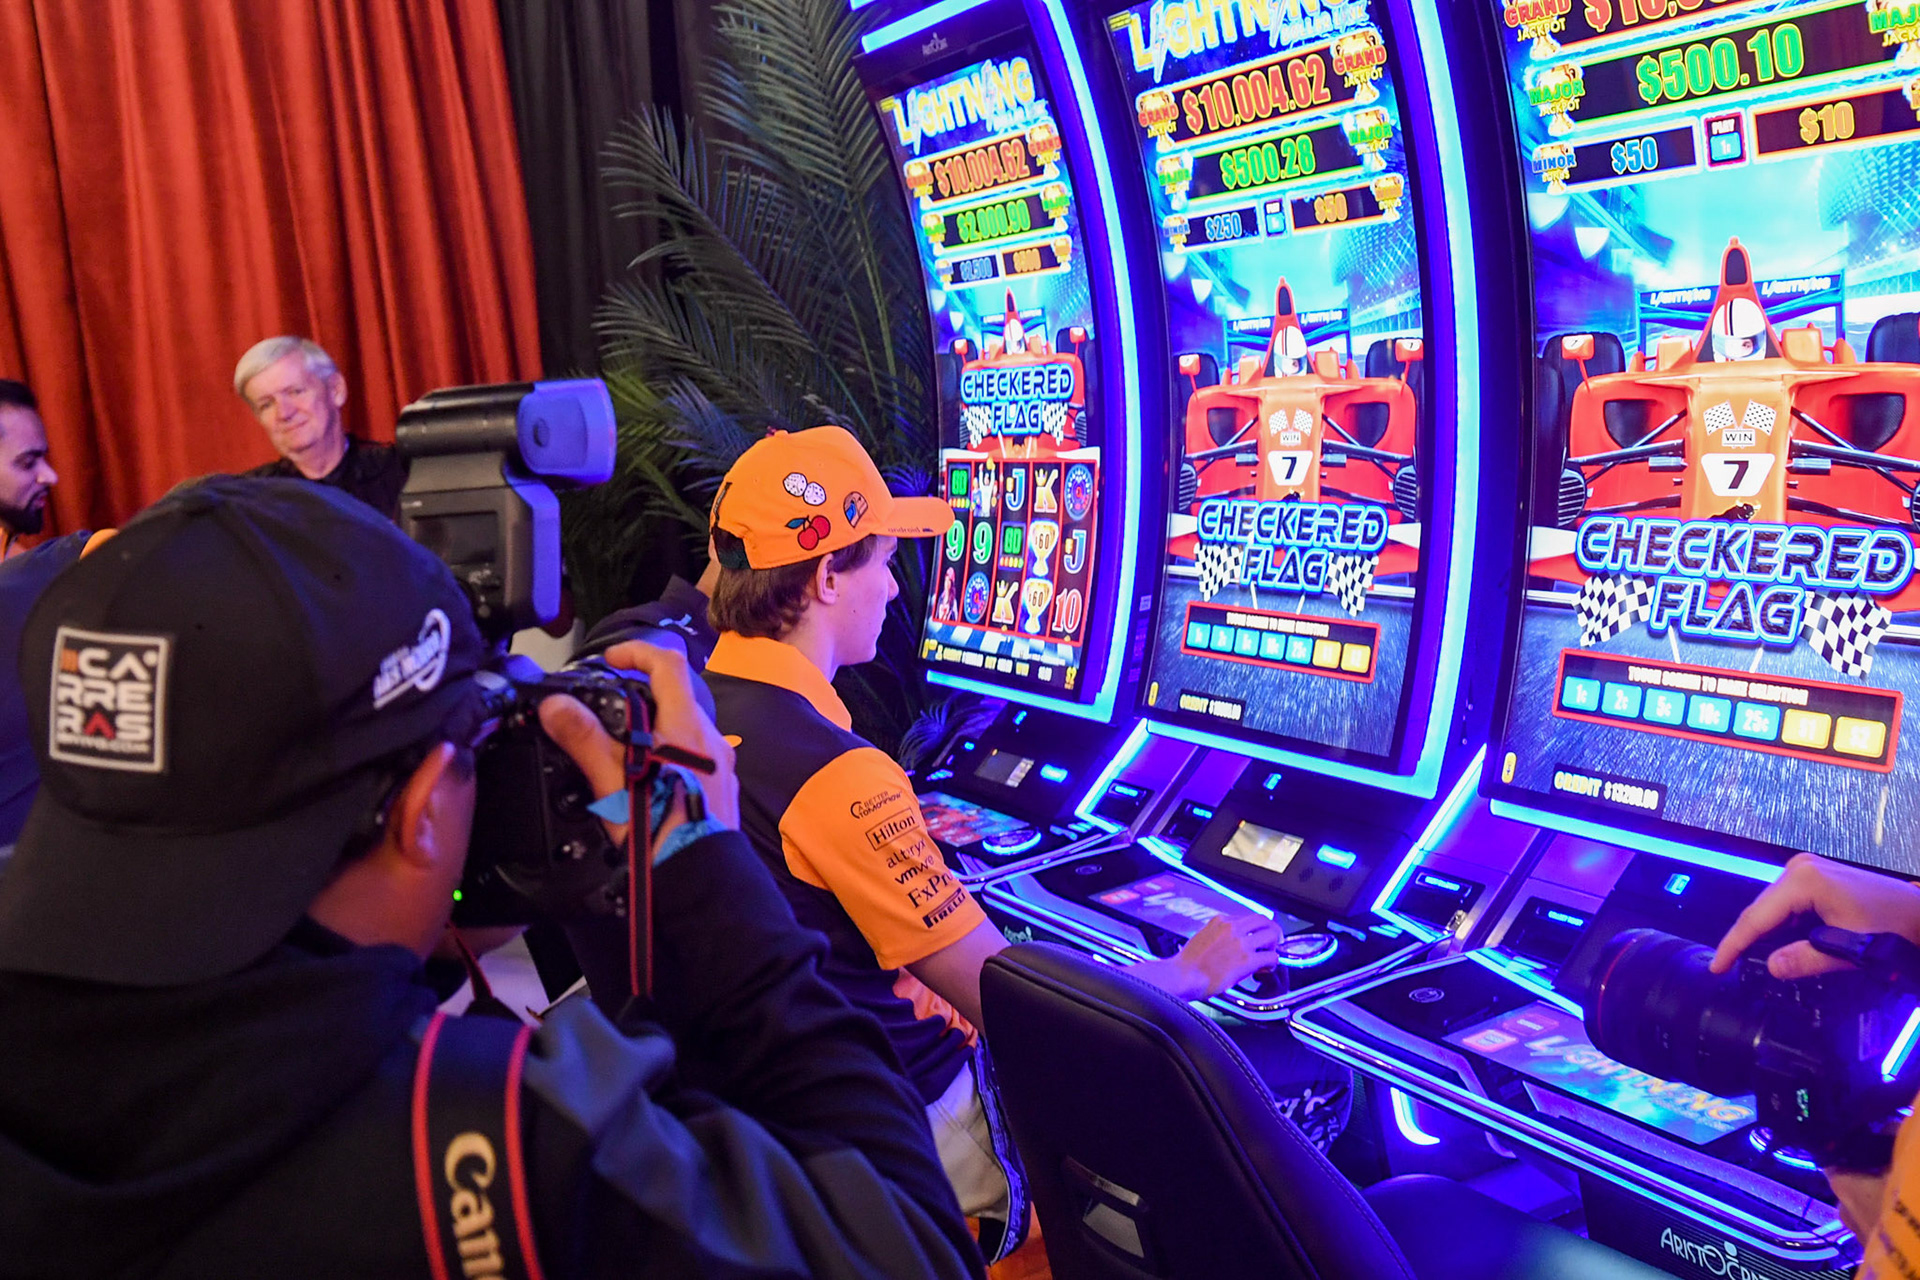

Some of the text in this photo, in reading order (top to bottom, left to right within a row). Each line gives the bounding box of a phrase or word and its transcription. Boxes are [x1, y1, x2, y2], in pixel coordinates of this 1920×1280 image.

[1504, 0, 1571, 27] GRAND
[1869, 3, 1920, 34] MAJ
[1518, 17, 1566, 42] JACKPOT
[1882, 26, 1920, 47] JACK
[1333, 45, 1387, 74] GRAND
[1636, 23, 1805, 105] $500.10
[1343, 68, 1383, 88] JACKPOT
[1529, 78, 1586, 105] MAJOR
[1182, 53, 1331, 135] $10,004.62
[1539, 98, 1581, 117] JACKPOT
[1138, 105, 1179, 127] GRAND
[1711, 118, 1735, 135] PLAY
[1798, 101, 1855, 145] $10
[1348, 123, 1393, 146] MAJOR
[934, 138, 1030, 198] $10,004.62
[1219, 134, 1316, 190] $500.28
[1531, 154, 1577, 173] MINOR
[1610, 136, 1658, 175] $50
[956, 198, 1031, 243] $2,000.90
[1314, 193, 1348, 224] $50
[1204, 212, 1242, 242] $250
[1650, 288, 1712, 307] LIGHTNING
[1761, 276, 1831, 297] LIGHTNING
[961, 365, 1074, 402] CHECKERED
[991, 402, 1042, 434] FLAG
[1725, 432, 1753, 443] WIN
[1282, 456, 1297, 480] 7
[1723, 460, 1749, 490] 7
[1199, 501, 1389, 549] CHECKERED
[945, 520, 966, 562] 9
[973, 521, 993, 564] 9
[1578, 518, 1912, 593] CHECKERED
[1241, 546, 1327, 589] FLAG
[1051, 588, 1083, 634] 10
[1652, 578, 1803, 642] FLAG
[57, 673, 152, 713] RRE
[864, 790, 889, 808] BETTER
[1554, 770, 1602, 798] CREDIT
[872, 815, 916, 845] Hilton
[922, 887, 967, 929] PIRELLI
[445, 1131, 506, 1280] Can
